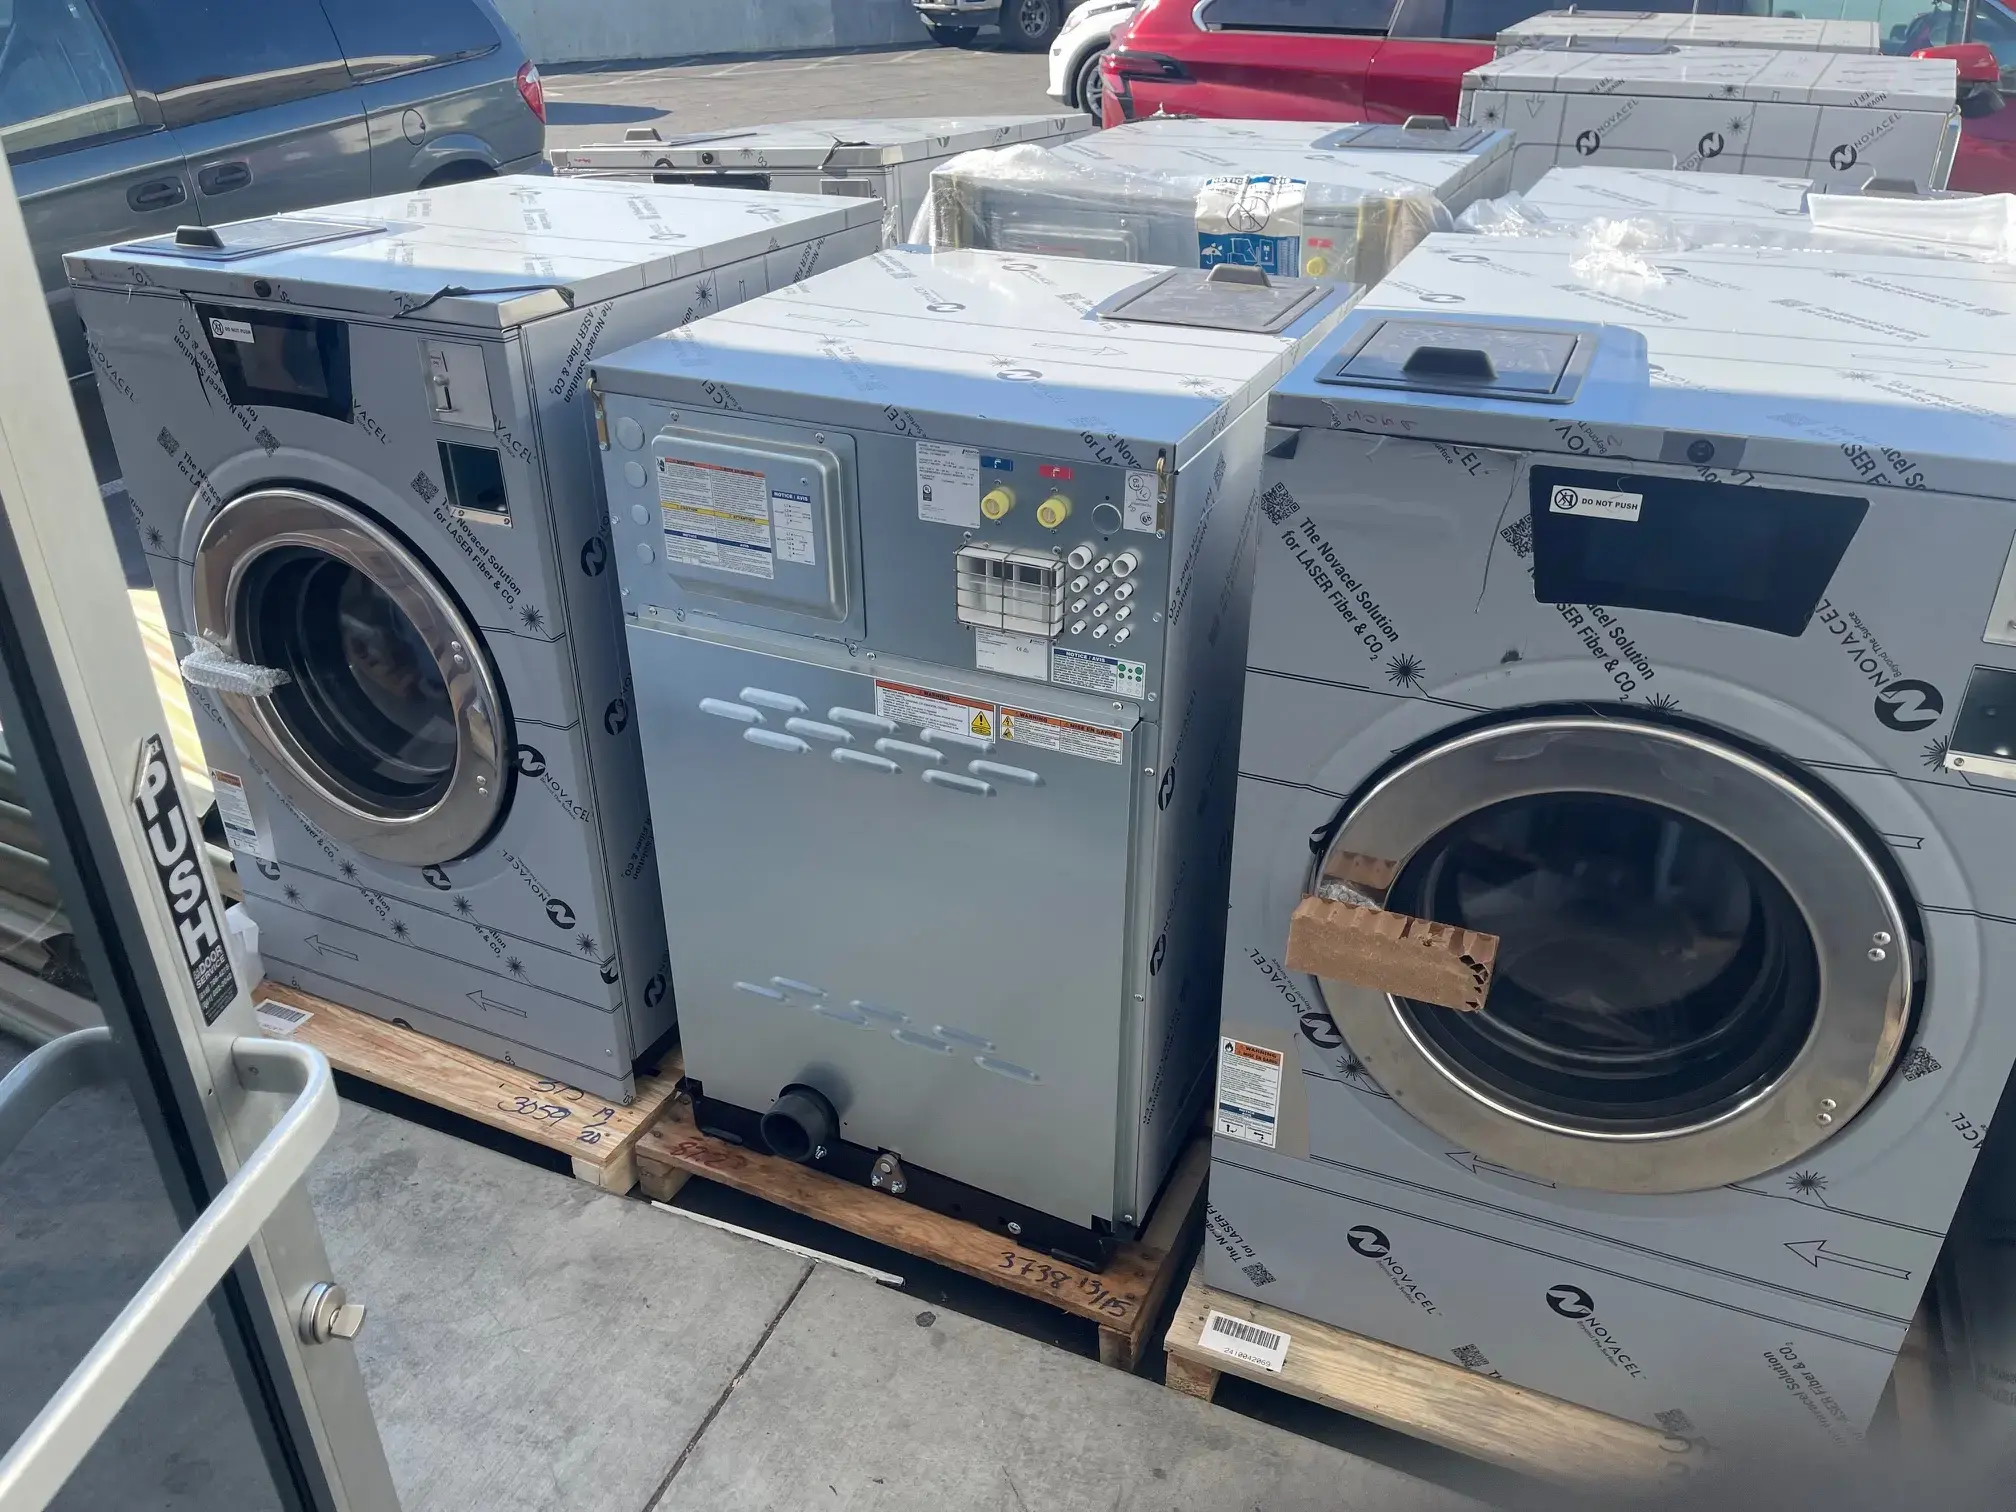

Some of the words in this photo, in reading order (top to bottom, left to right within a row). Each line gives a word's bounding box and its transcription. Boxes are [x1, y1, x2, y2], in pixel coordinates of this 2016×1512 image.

[1597, 98, 1639, 134] NOVACEL
[1853, 112, 1902, 149] NOVACEL
[578, 306, 598, 341] ASER
[584, 317, 605, 362] Novacel
[174, 335, 205, 376] Solution
[565, 337, 583, 368] Fiber
[561, 367, 570, 377] &
[563, 359, 586, 404] Solution
[206, 375, 237, 414] Novacel
[237, 411, 252, 432] The
[246, 405, 259, 421] for
[177, 461, 189, 476] for
[183, 451, 197, 470] The
[197, 469, 222, 503] Novace
[774, 491, 793, 500] NOTICE
[1581, 498, 1593, 506] DO
[1595, 499, 1613, 508] NOT
[1615, 501, 1638, 510] PUSH
[433, 507, 447, 524] for
[446, 522, 474, 557] LASER
[472, 555, 494, 581] Fiber
[493, 580, 501, 590] &
[456, 517, 489, 556] Novacel
[487, 553, 522, 596] Solution
[1281, 530, 1300, 551] for
[1295, 549, 1334, 593] LASER
[1328, 590, 1358, 623] Fiber
[1354, 622, 1367, 636] &
[1300, 517, 1320, 544] The
[1317, 541, 1362, 593] Novacel
[1356, 590, 1399, 643] Solution
[1848, 610, 1871, 639] Surface
[1066, 651, 1088, 660] NOTICE
[1577, 625, 1608, 660] Fiber
[1604, 659, 1619, 673] &
[1608, 626, 1655, 681] Solution
[1815, 598, 1890, 688] NOVACEL
[1869, 637, 1882, 654] The
[1879, 652, 1902, 678] Beyond
[1019, 713, 1048, 723] WARNING
[544, 772, 591, 823] NOVACEL
[138, 760, 220, 966] PUSH
[501, 849, 547, 902] NOVACEL
[196, 954, 226, 989] SERVICE
[199, 945, 223, 974] DOOR
[1249, 948, 1306, 1014] NOVACEL
[1245, 1046, 1277, 1059] WARNING
[1214, 1214, 1244, 1244] LASER
[1226, 1244, 1241, 1263] The
[1241, 1245, 1256, 1258] for
[1382, 1256, 1437, 1315] NOVACEL
[1585, 1317, 1642, 1379] NOVACEL
[1792, 1361, 1806, 1370] &
[1763, 1351, 1800, 1391] Solution
